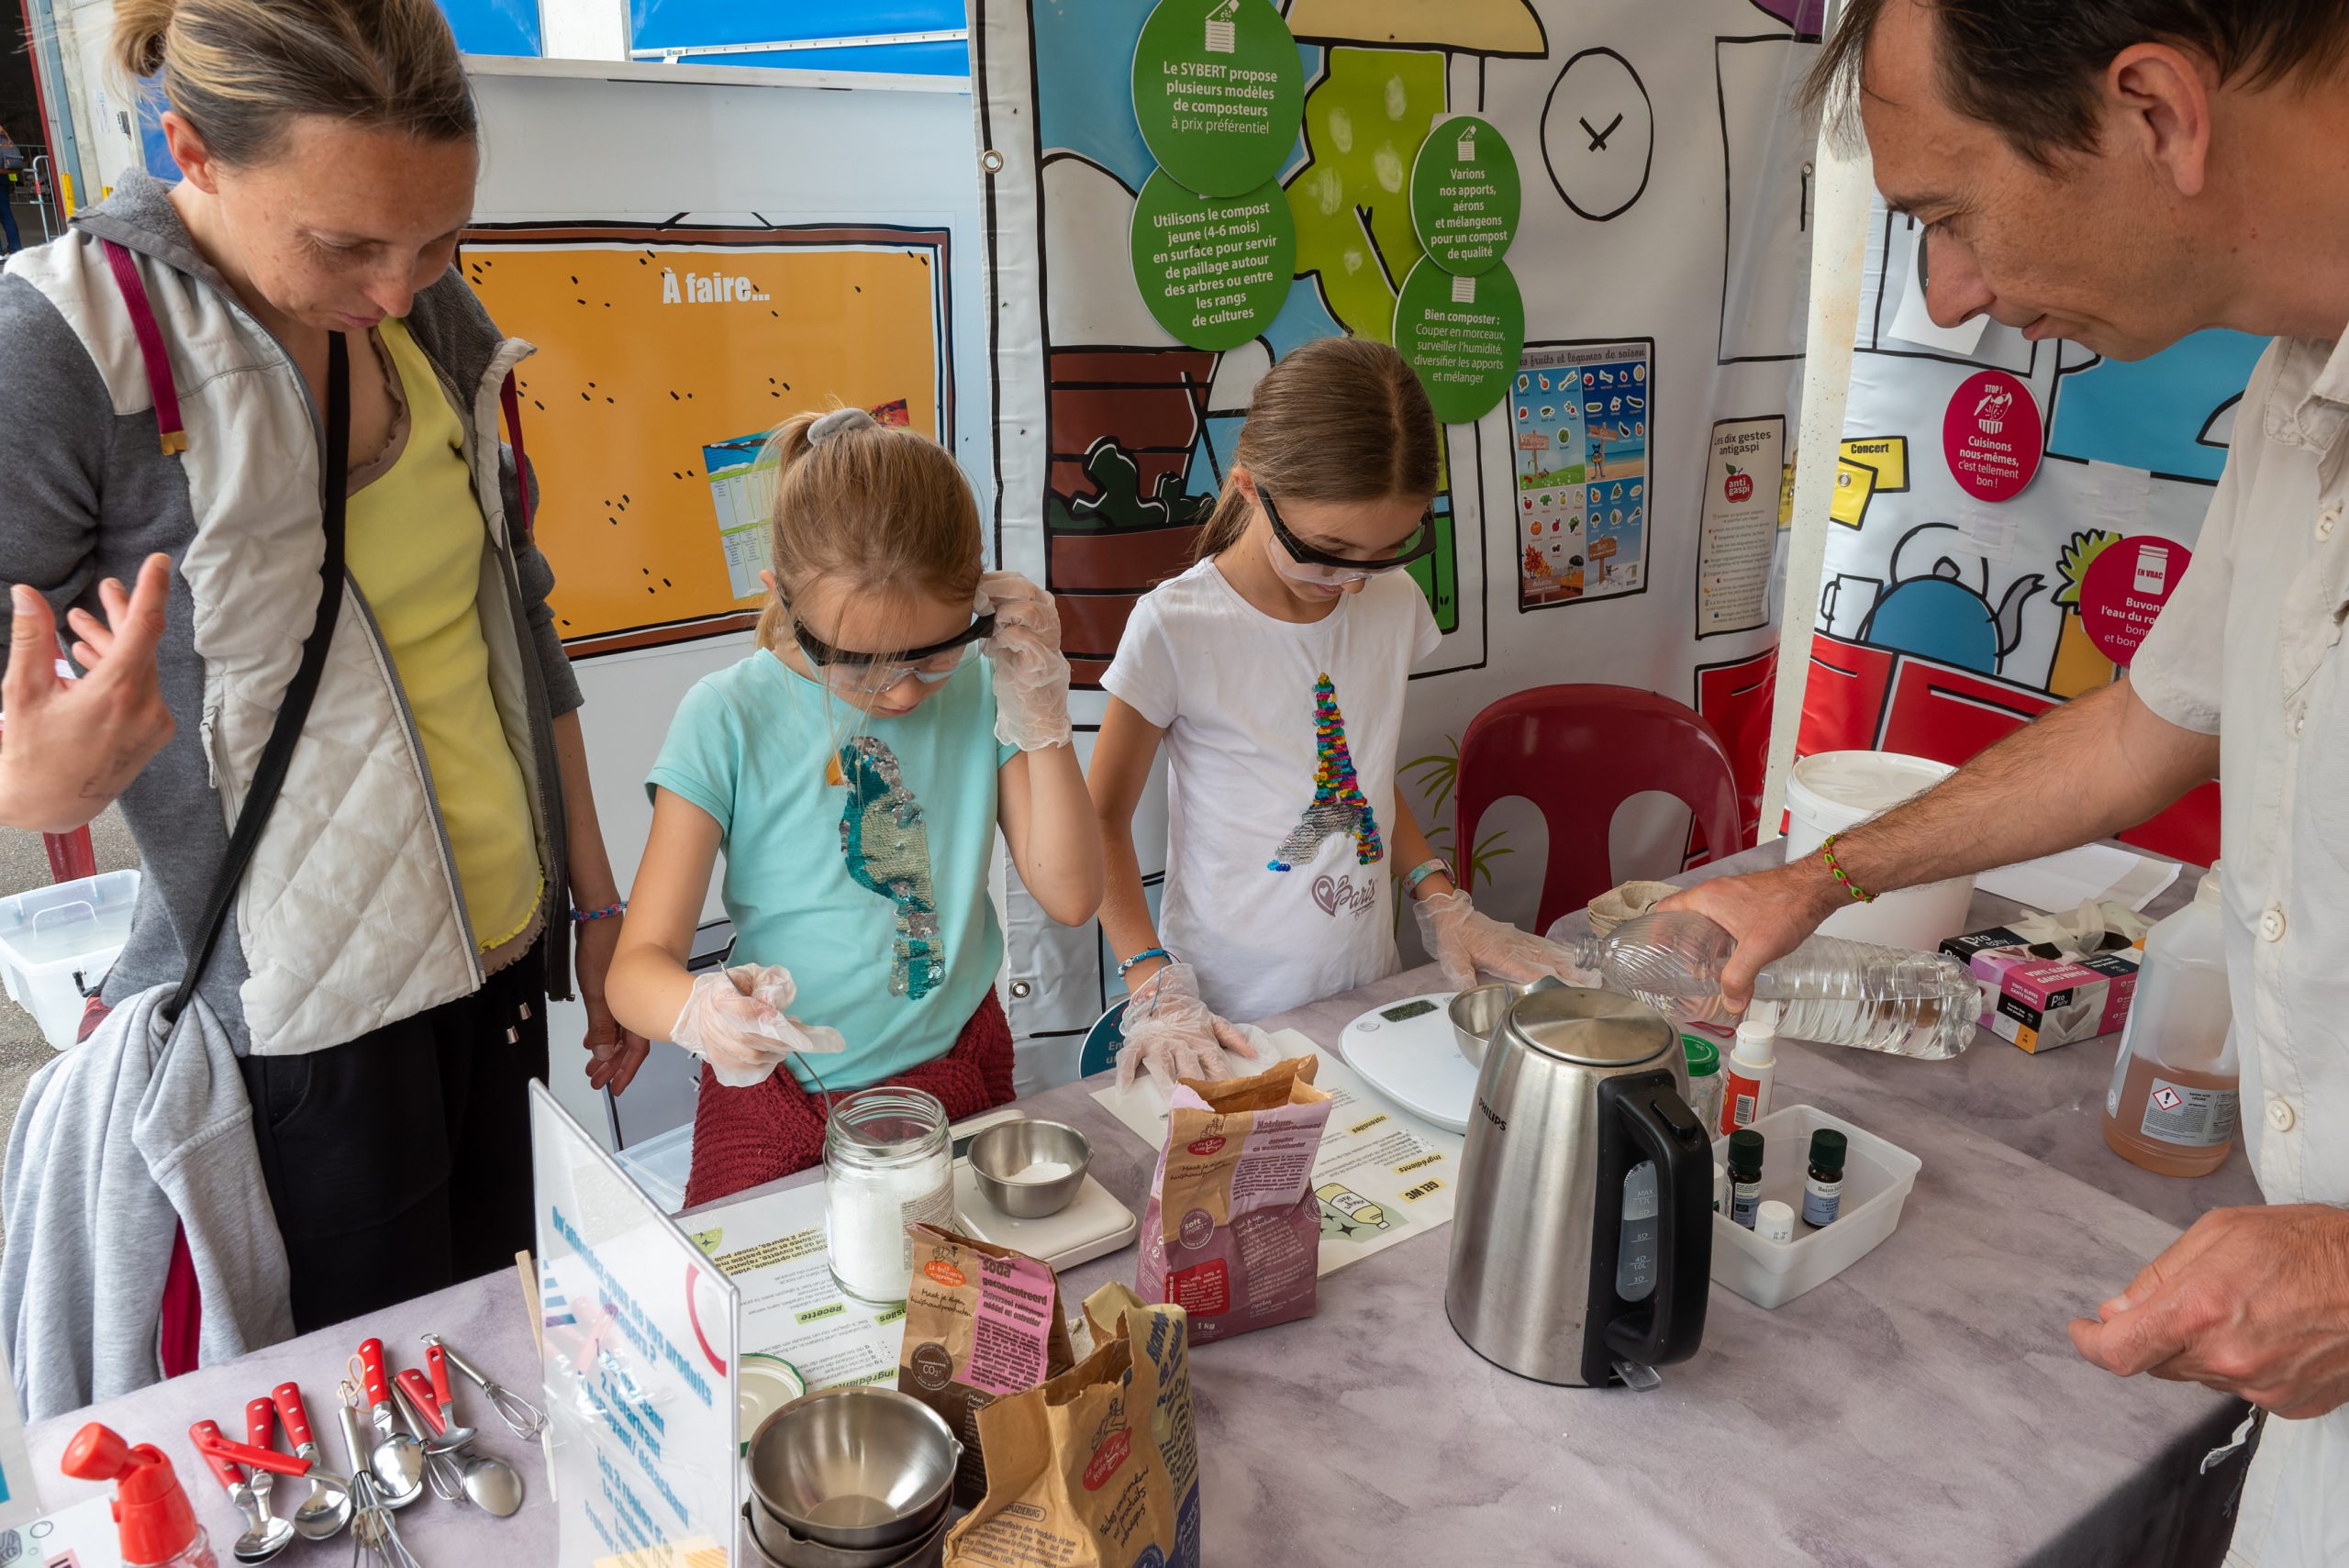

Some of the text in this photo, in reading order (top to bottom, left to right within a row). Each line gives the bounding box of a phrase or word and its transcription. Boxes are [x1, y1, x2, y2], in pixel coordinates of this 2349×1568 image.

[1163, 61, 1278, 83] Le SYBERT propose
[1166, 80, 1275, 100] plusieurs modèles
[1174, 98, 1268, 117] de composteurs
[1171, 116, 1270, 134] à prix préférentiel
[1451, 168, 1486, 180] Varions
[1440, 184, 1497, 198] nos apports,
[1453, 200, 1485, 212] aérons
[1153, 202, 1270, 228] Utilisons le compost
[1435, 216, 1502, 229] et mélangeons
[1167, 219, 1260, 248] jeune (4-6 mois)
[1431, 230, 1508, 248] pour un compost
[1152, 235, 1277, 263] en surface pour servir
[1447, 245, 1493, 261] de qualité
[1165, 254, 1269, 280] de paillage autour
[662, 266, 770, 304] À faire...
[1164, 271, 1274, 297] des arbres ou entre
[1196, 292, 1247, 309] les rangs
[1192, 307, 1254, 328] de cultures
[1424, 308, 1496, 326] Bien composter
[1416, 323, 1506, 341] Couper en morceaux,
[1417, 340, 1456, 352] surveiller
[1414, 353, 1504, 371] diversifier les apports
[1529, 349, 1645, 368] fruits et légumes de saison
[1433, 372, 1484, 385] et mélanger
[1985, 384, 1999, 394] STOP
[1725, 433, 1736, 444] dix
[1738, 431, 1771, 444] gestes
[1968, 436, 2011, 452] Cuisinons
[1719, 441, 1759, 455] antigaspi
[1851, 443, 1889, 454] Concert
[1960, 449, 2019, 467] nous-mêmes,
[1958, 460, 2019, 479] c'est tellement
[1729, 478, 1745, 488] anti
[1976, 474, 1993, 487] bon
[1729, 484, 1750, 496] gaspi
[2137, 568, 2164, 580] EN VRAC
[2101, 605, 2125, 619] l'eau
[2128, 611, 2142, 622] du
[2104, 634, 2136, 648] et bon
[1479, 1096, 1508, 1131] PHILIPS
[1352, 1116, 1386, 1134] Ustensiles
[1398, 1154, 1442, 1174] Ingrédients
[1405, 1181, 1440, 1200] GEL WC
[1638, 1189, 1653, 1197] MAX
[1185, 1218, 1201, 1230] soft
[732, 1245, 757, 1257] rincer
[758, 1236, 790, 1249] heures,
[763, 1244, 778, 1253] une
[731, 1249, 762, 1263] pastille
[759, 1248, 794, 1262] cuvette,
[725, 1260, 759, 1273] rajouter
[729, 1268, 751, 1277] vider
[982, 1257, 1012, 1279] soda
[921, 1288, 940, 1300] Maak
[941, 1293, 948, 1302] je
[982, 1276, 1048, 1307] geconcentreerd
[800, 1305, 842, 1322] Recette
[879, 1307, 906, 1323] nsiles
[983, 1301, 1004, 1314] middel
[1005, 1307, 1012, 1318] en
[1204, 1322, 1216, 1330] kg
[631, 1299, 644, 1328] de
[645, 1316, 663, 1350] vos
[665, 1340, 712, 1409] produits
[610, 1383, 661, 1463] Détartrant
[597, 1446, 652, 1534] Les 3 règles
[639, 1449, 689, 1529] détachant
